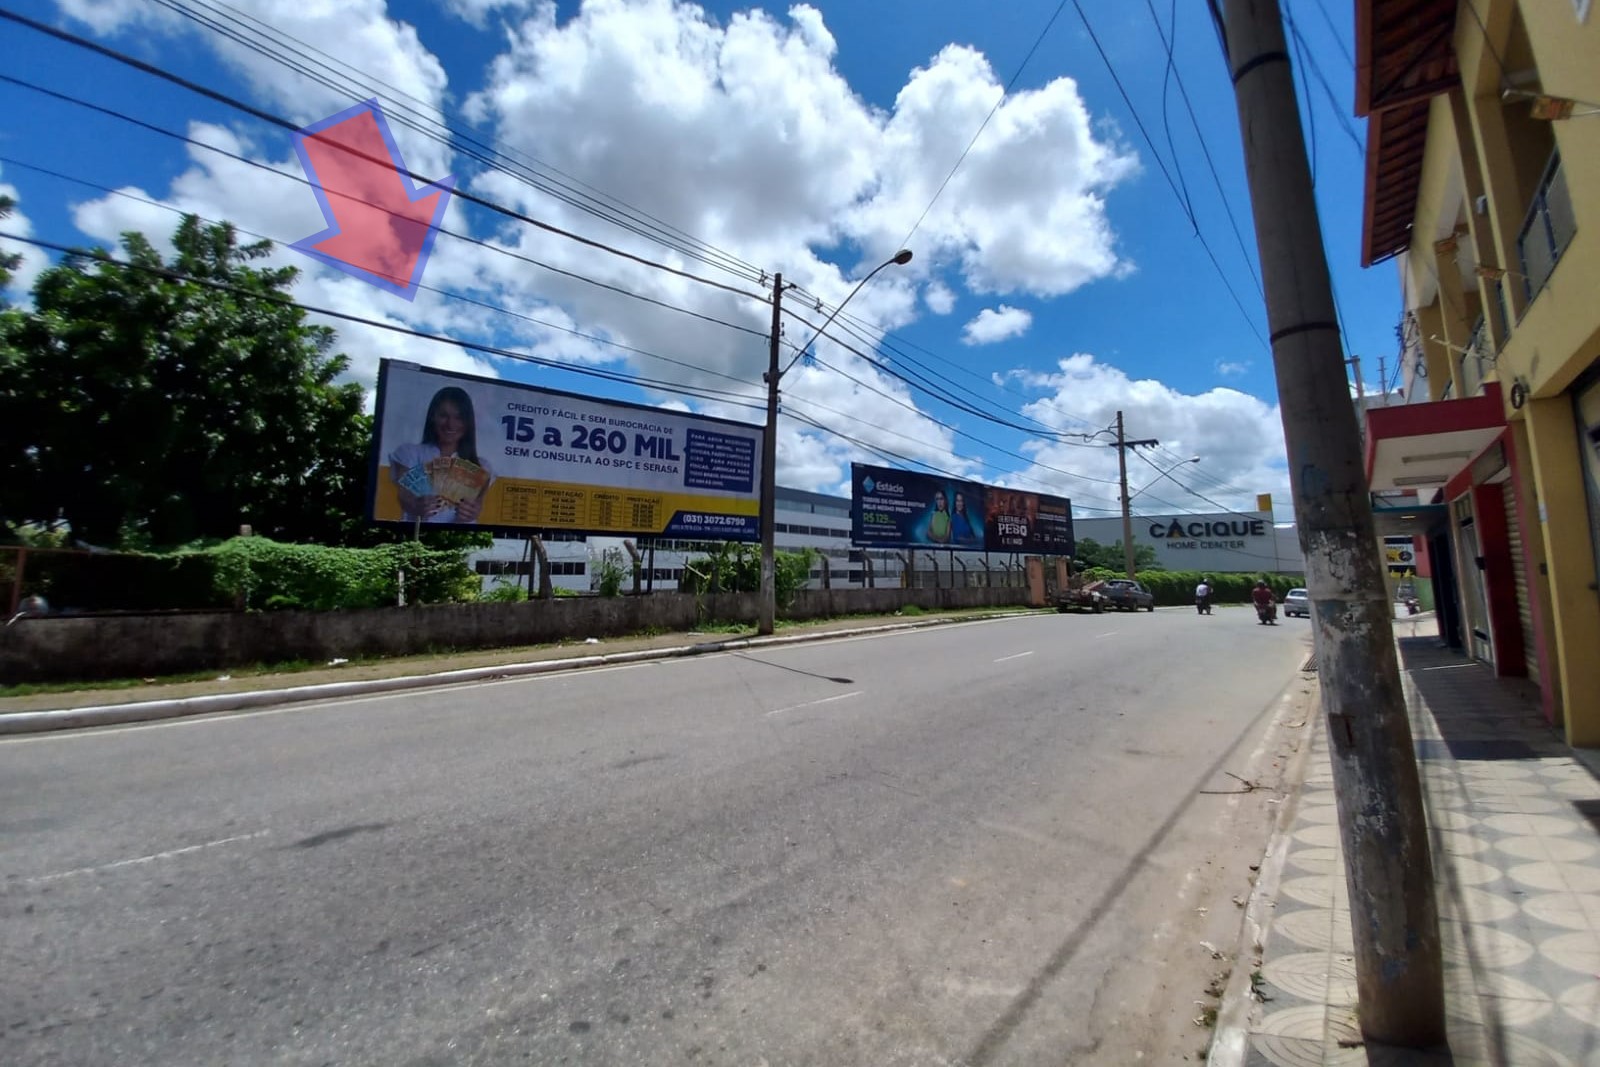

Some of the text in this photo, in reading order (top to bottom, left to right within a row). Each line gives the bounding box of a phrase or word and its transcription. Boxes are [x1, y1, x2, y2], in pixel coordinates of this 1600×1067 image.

[588, 414, 607, 424] SEM
[608, 418, 662, 433] BUROCRACIA
[663, 427, 673, 435] DE
[501, 415, 680, 461] 15 a 260 MIL
[504, 446, 530, 458] SEM
[533, 449, 592, 465] CONSULTA
[595, 457, 610, 466] AO
[612, 458, 633, 469] SPC
[634, 461, 640, 470] E
[643, 462, 679, 474] SERASA
[682, 514, 703, 524] (031)
[1149, 518, 1265, 539] CACIQUE
[1167, 540, 1245, 550] HOME CENTER
